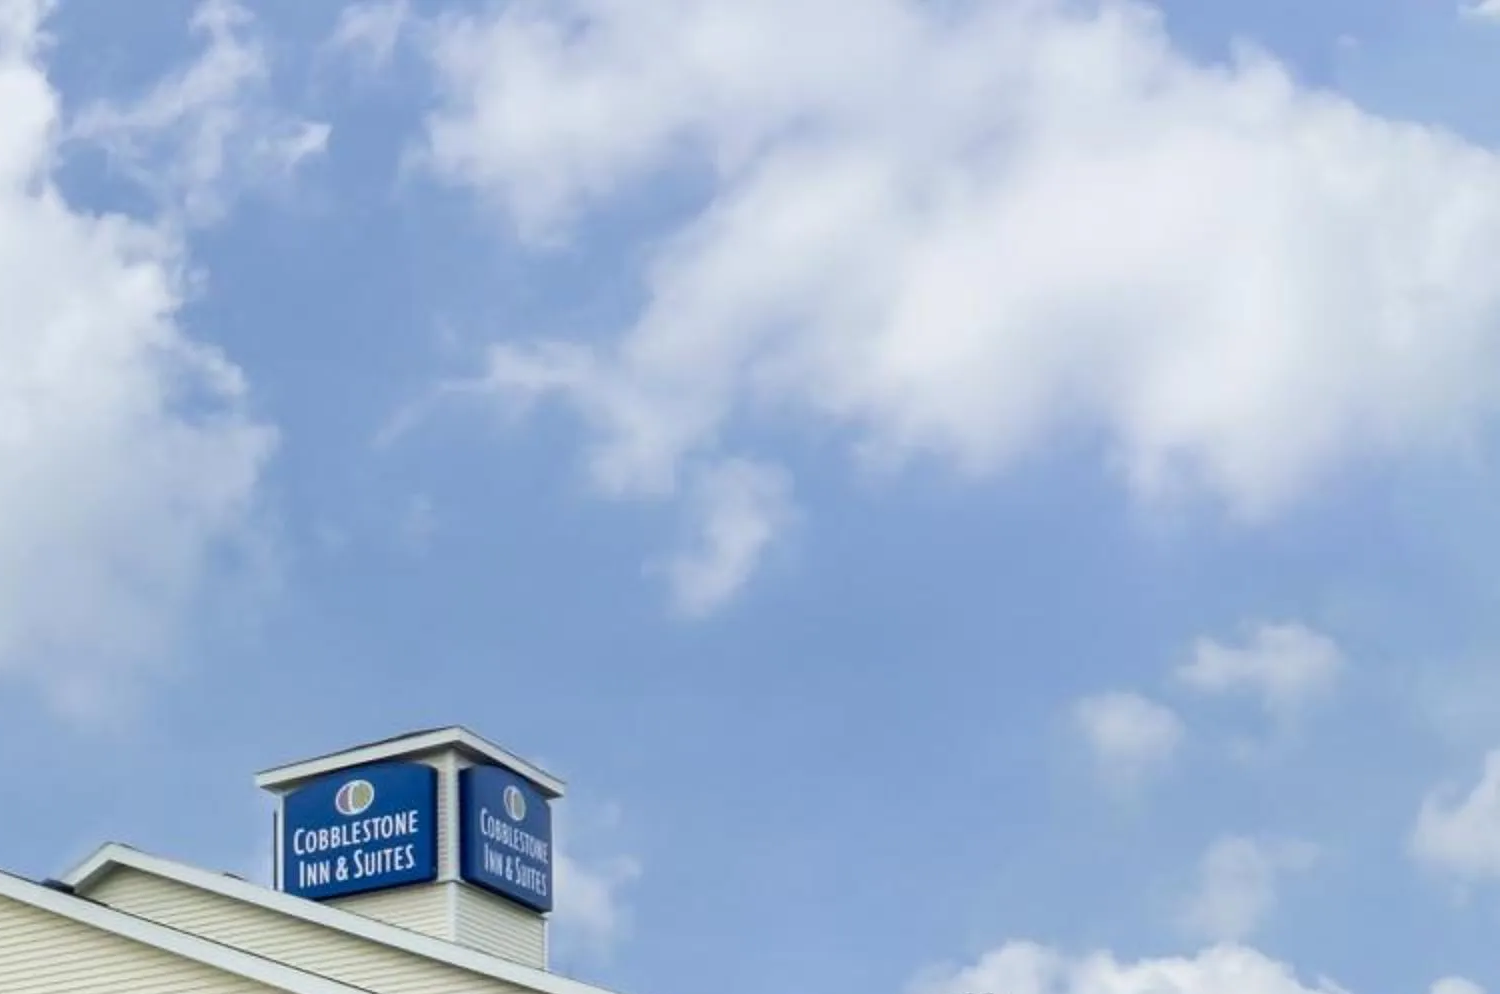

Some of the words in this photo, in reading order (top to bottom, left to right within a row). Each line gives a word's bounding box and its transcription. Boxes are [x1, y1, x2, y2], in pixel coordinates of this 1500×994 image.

[293, 809, 419, 855] COBBLESTONE
[479, 808, 549, 865] COBBLESTONE
[299, 860, 330, 888] INN
[336, 856, 349, 881] &
[353, 844, 415, 878] SUITES
[483, 844, 503, 877] INN
[505, 859, 514, 882] &
[515, 856, 547, 897] SUITES
